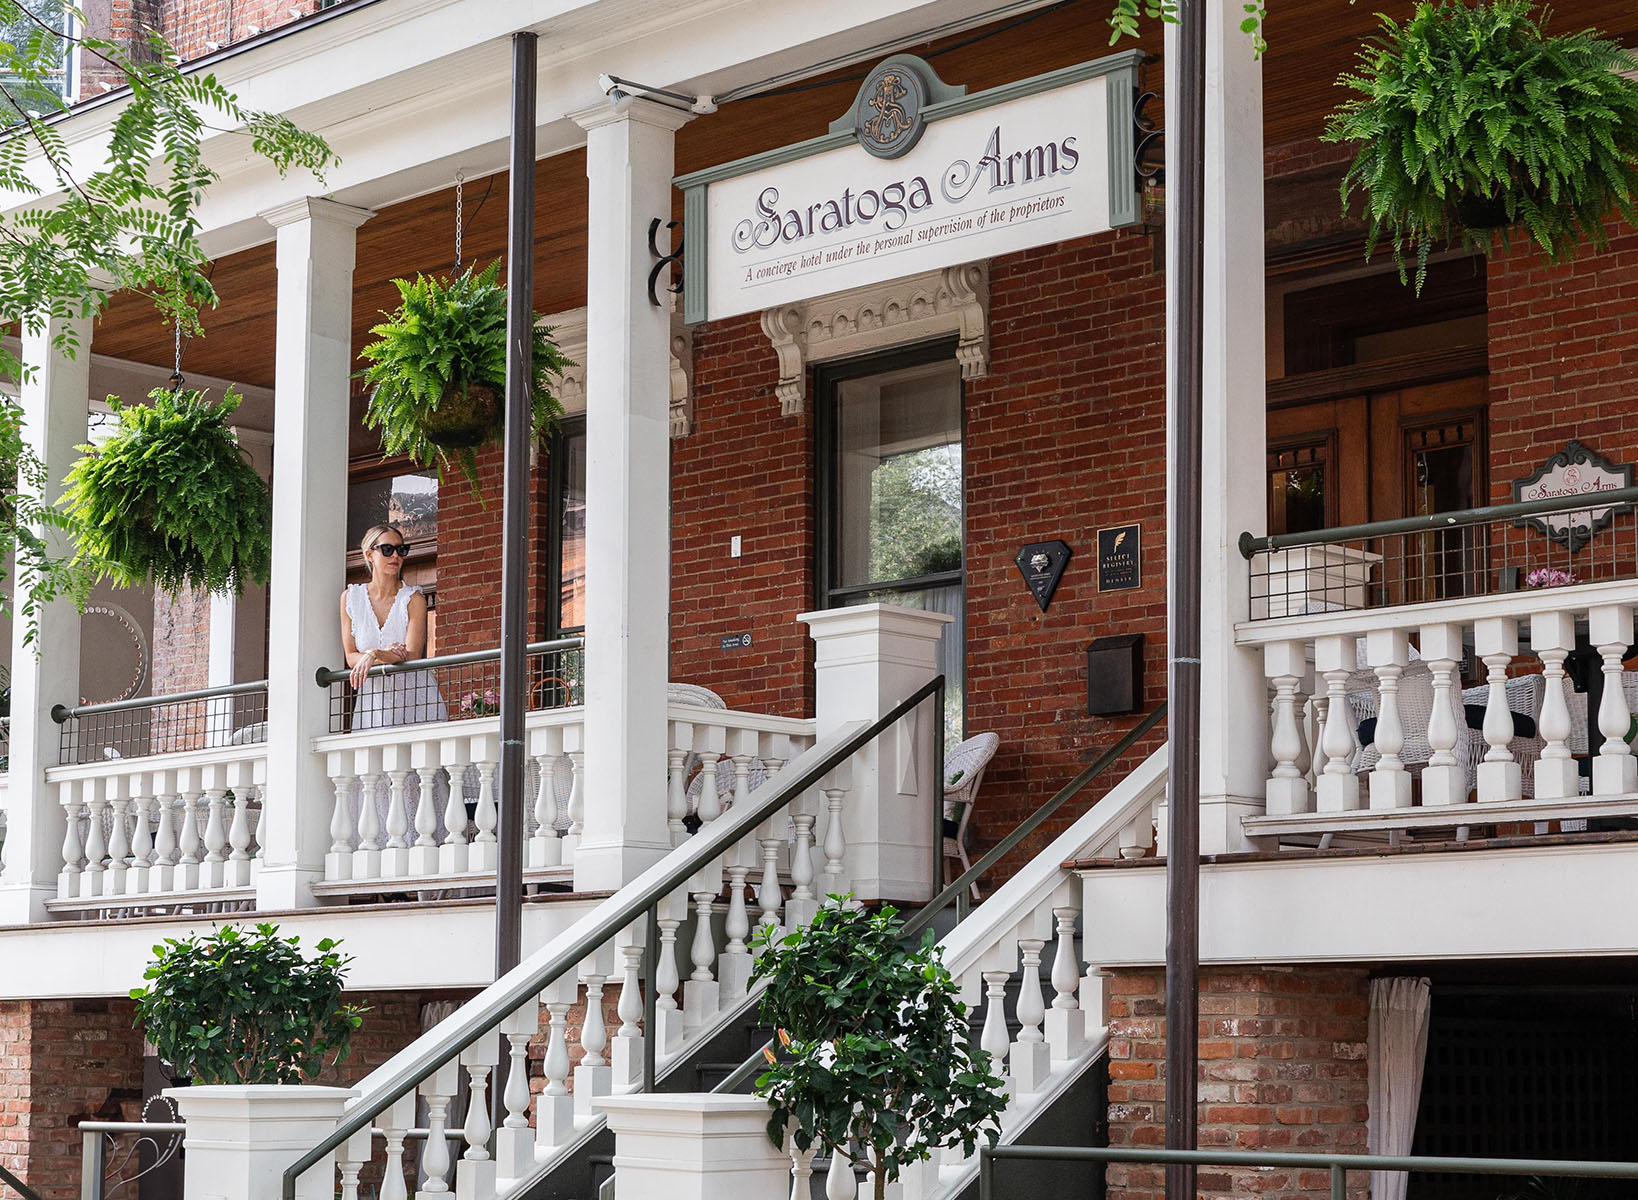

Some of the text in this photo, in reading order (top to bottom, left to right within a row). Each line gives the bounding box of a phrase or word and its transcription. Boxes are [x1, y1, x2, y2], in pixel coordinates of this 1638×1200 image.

[733, 126, 1079, 251] Saratoga Arms
[745, 195, 1065, 282] A concierge hotel under the personal supervision of the proprietors
[1528, 476, 1617, 499] Saratoga Arms
